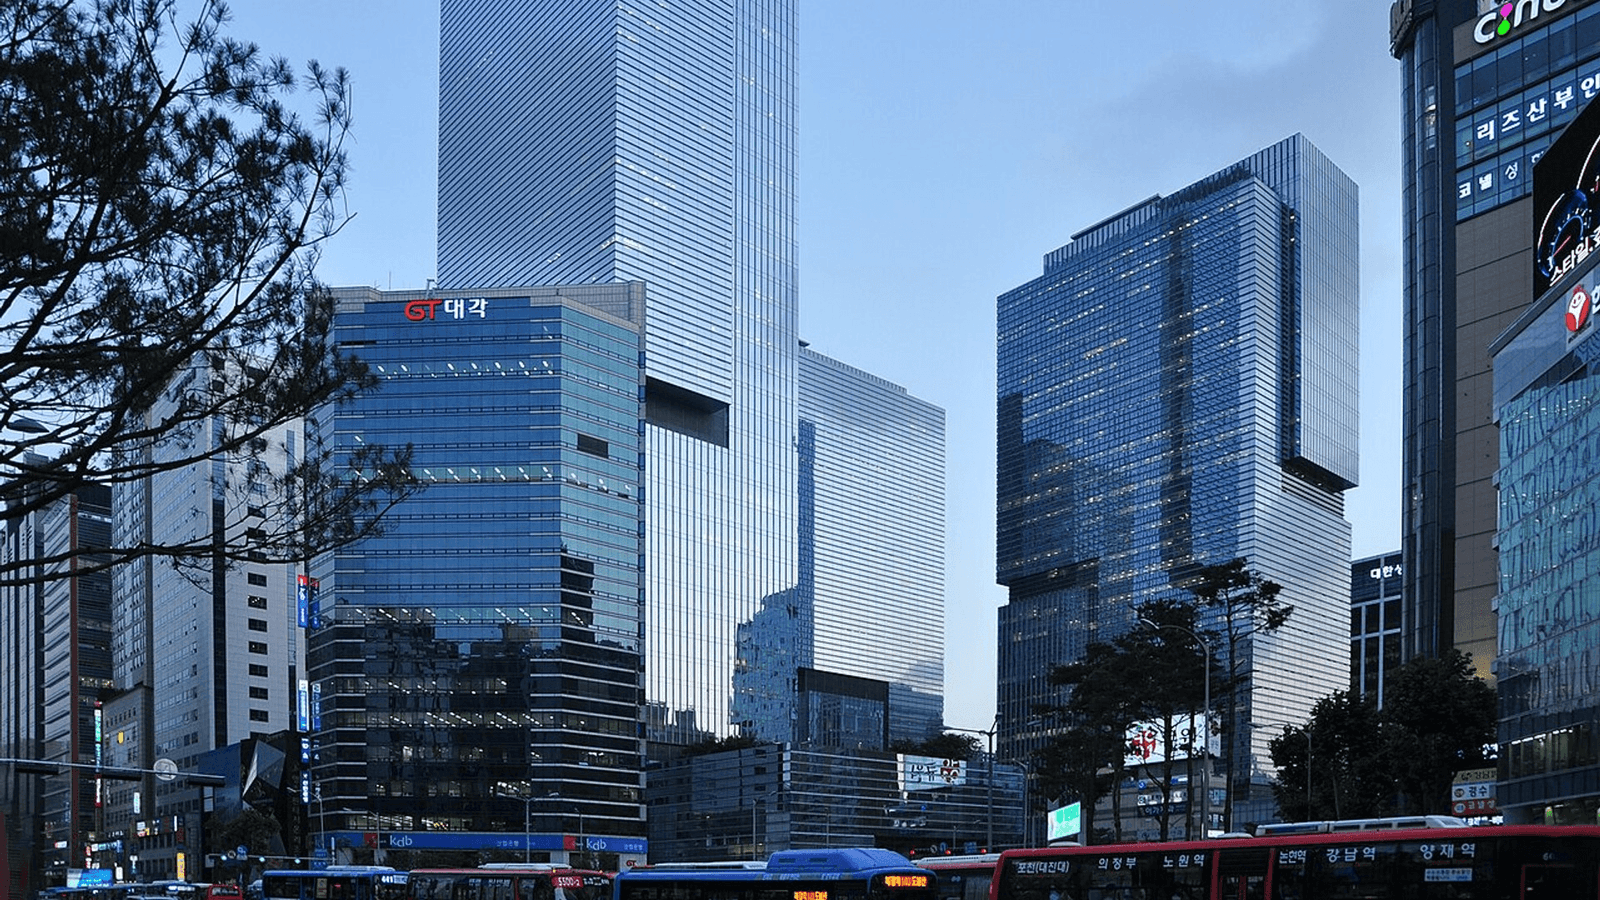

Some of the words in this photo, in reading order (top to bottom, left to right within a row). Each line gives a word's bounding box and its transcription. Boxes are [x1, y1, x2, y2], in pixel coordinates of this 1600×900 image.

[444, 299, 488, 319] 대각
[389, 835, 413, 847] kdb
[586, 838, 607, 851] kdb
[1279, 850, 1307, 864] 논현역
[1326, 847, 1376, 863] 강남역
[1420, 843, 1475, 860] 양재역
[1017, 860, 1070, 875] 포천(대진대)
[1098, 857, 1137, 870] 의정부
[1162, 854, 1205, 868] 노원역
